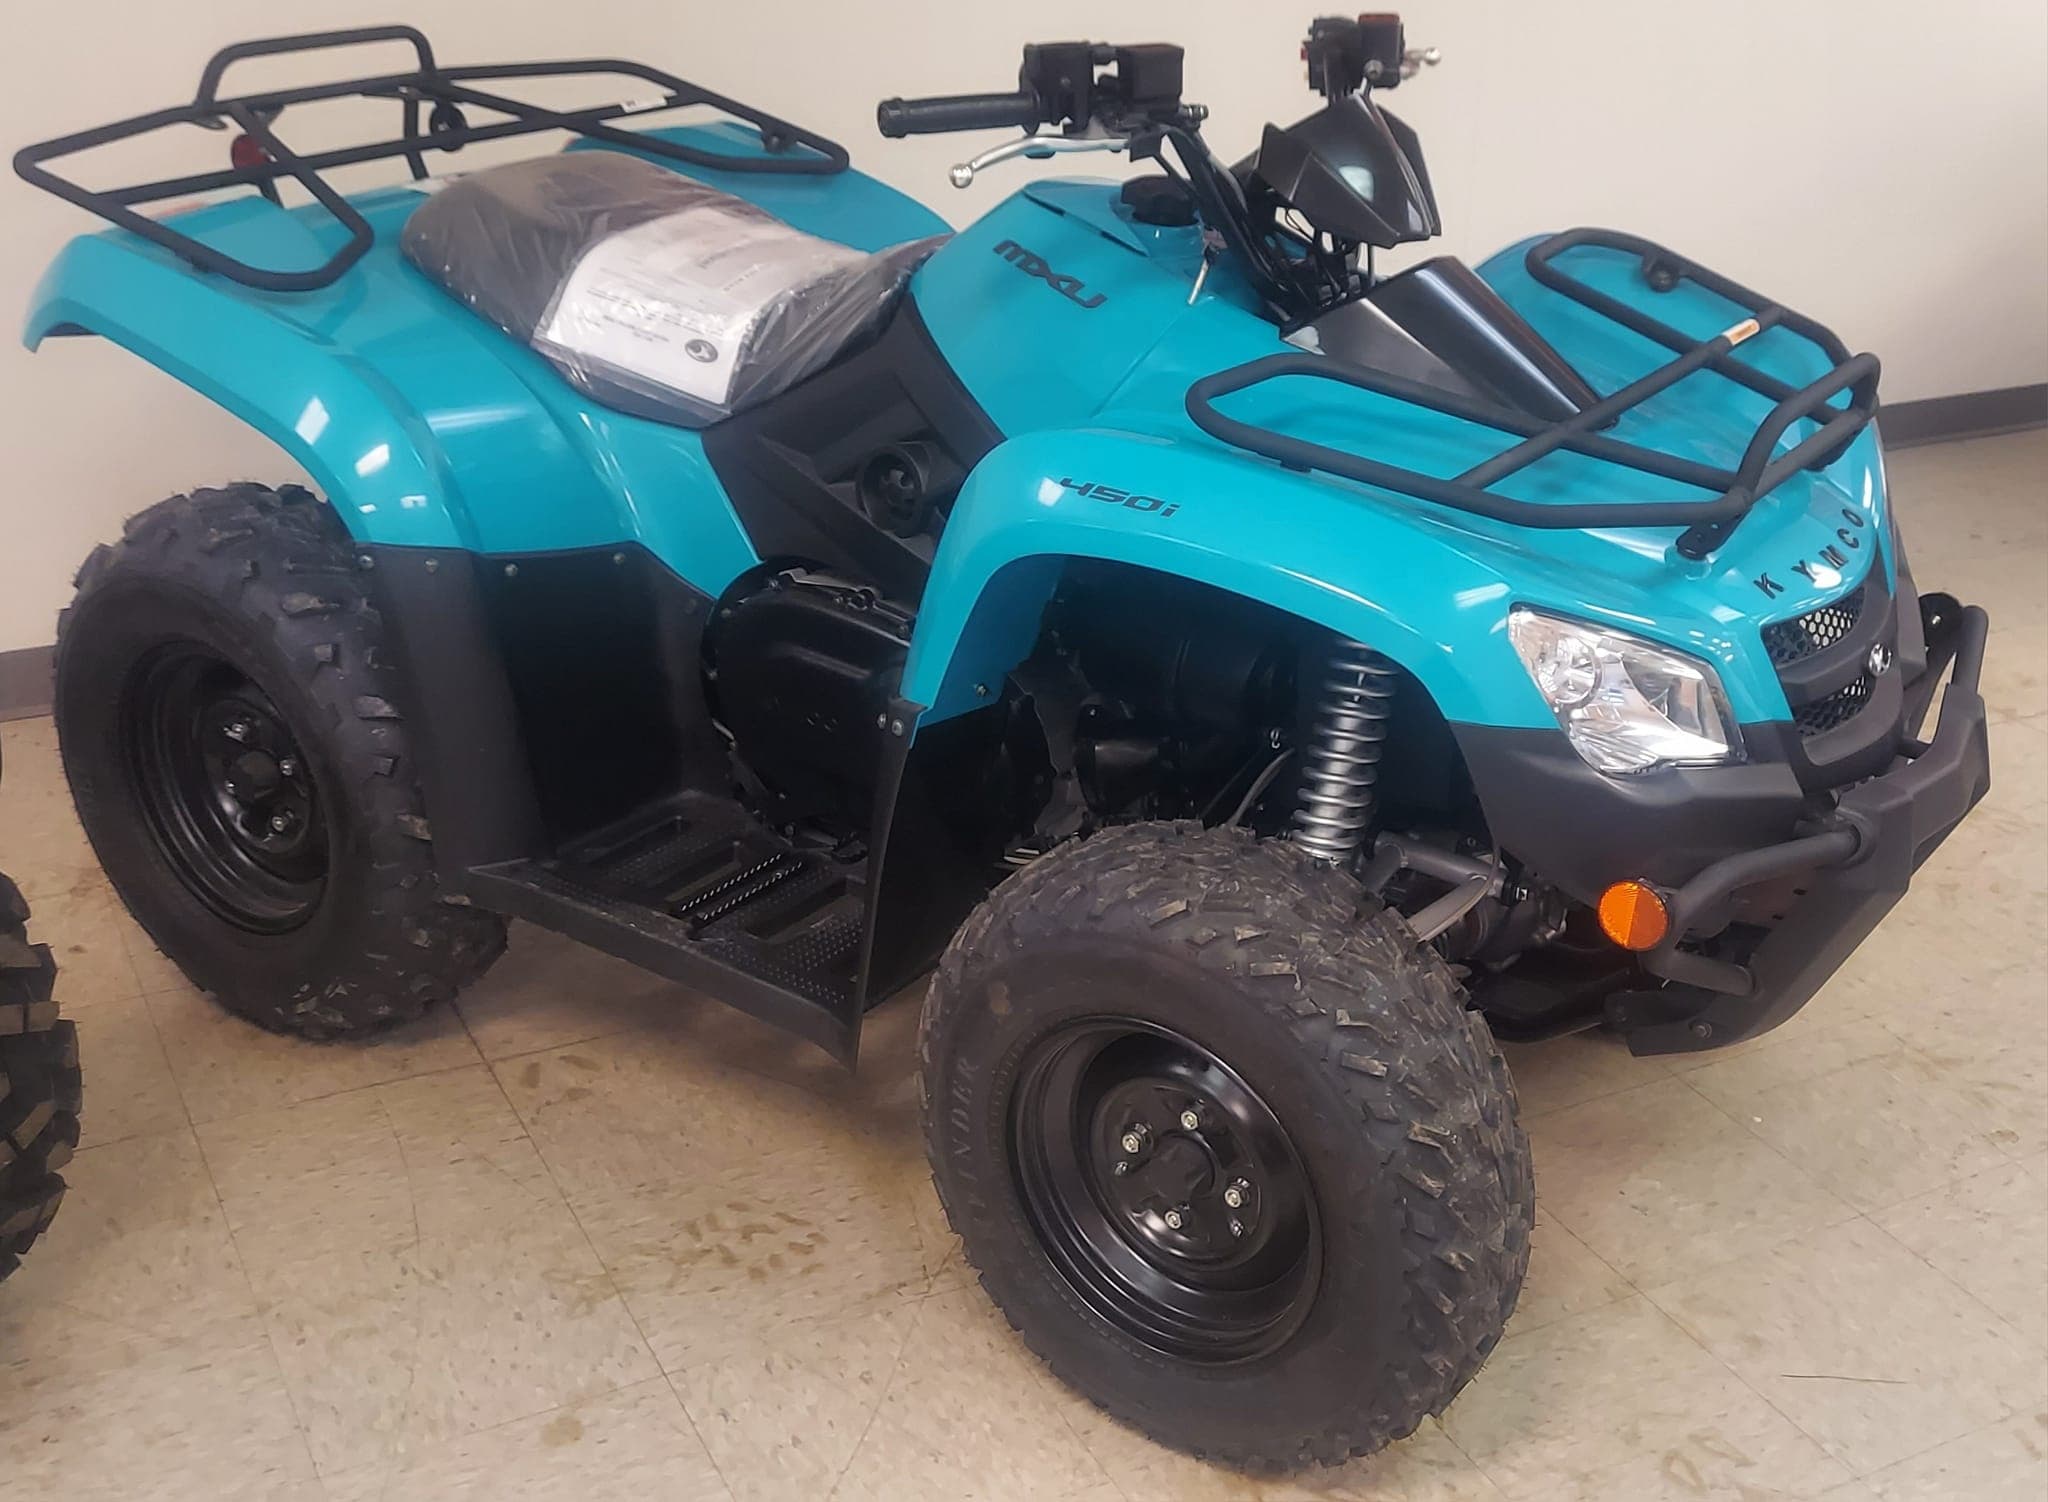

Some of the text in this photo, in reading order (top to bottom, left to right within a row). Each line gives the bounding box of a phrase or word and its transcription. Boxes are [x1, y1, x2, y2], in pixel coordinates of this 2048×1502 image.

[992, 239, 1109, 309] MXU
[1059, 477, 1181, 518] 450i
[1753, 508, 1865, 600] KYMCO
